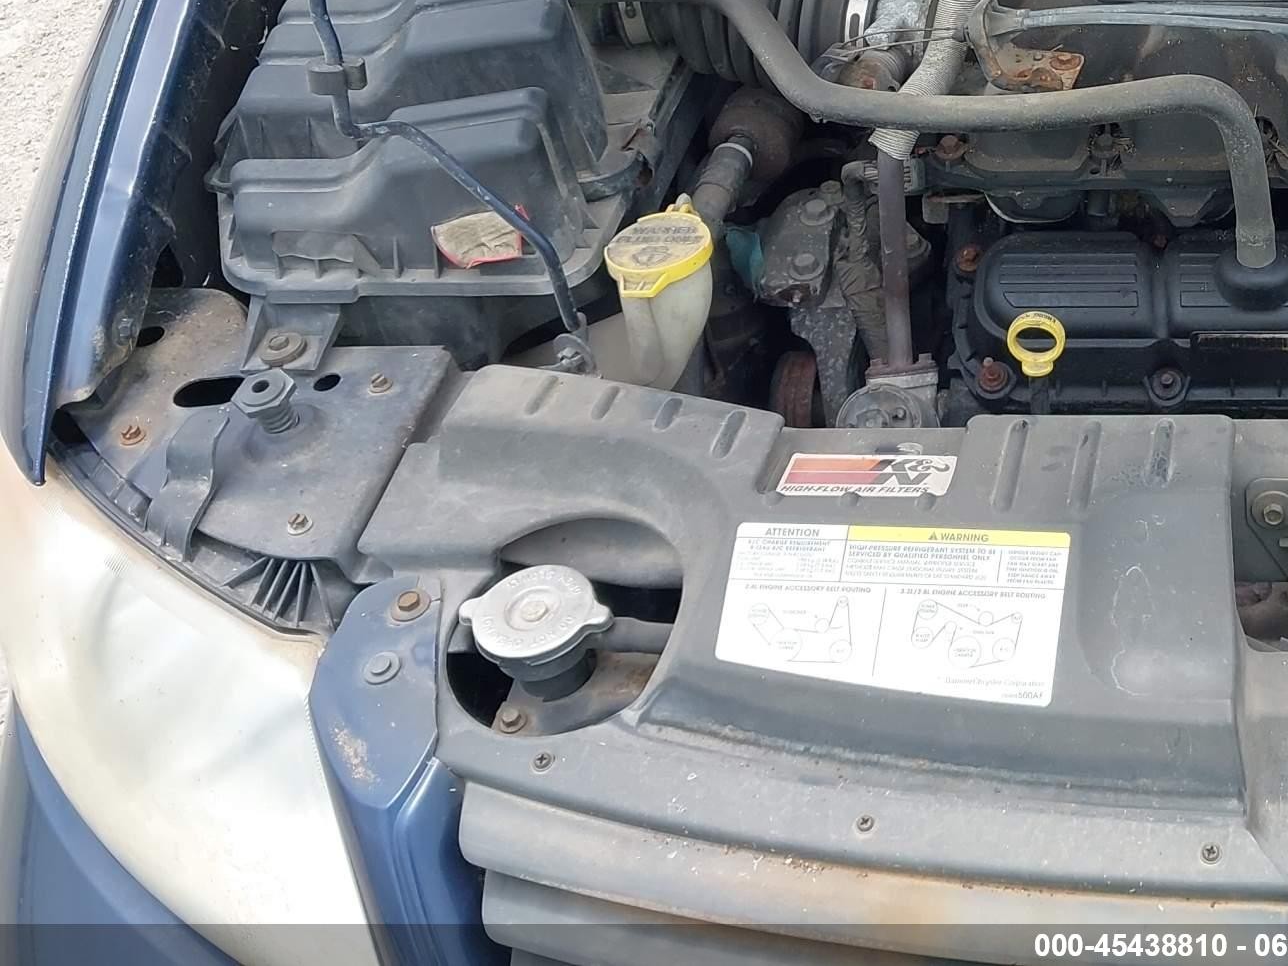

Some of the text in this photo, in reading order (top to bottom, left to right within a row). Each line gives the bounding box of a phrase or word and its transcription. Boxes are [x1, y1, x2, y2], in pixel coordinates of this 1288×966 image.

[780, 485, 851, 493] HIGH-FLOW
[877, 486, 930, 494] FILTERS
[765, 528, 820, 537] ATTENTION
[940, 533, 989, 543] WARNING
[903, 545, 948, 553] REFRIGERANT
[931, 553, 969, 561] PERSONNEL
[958, 589, 999, 597] ACCESSORY
